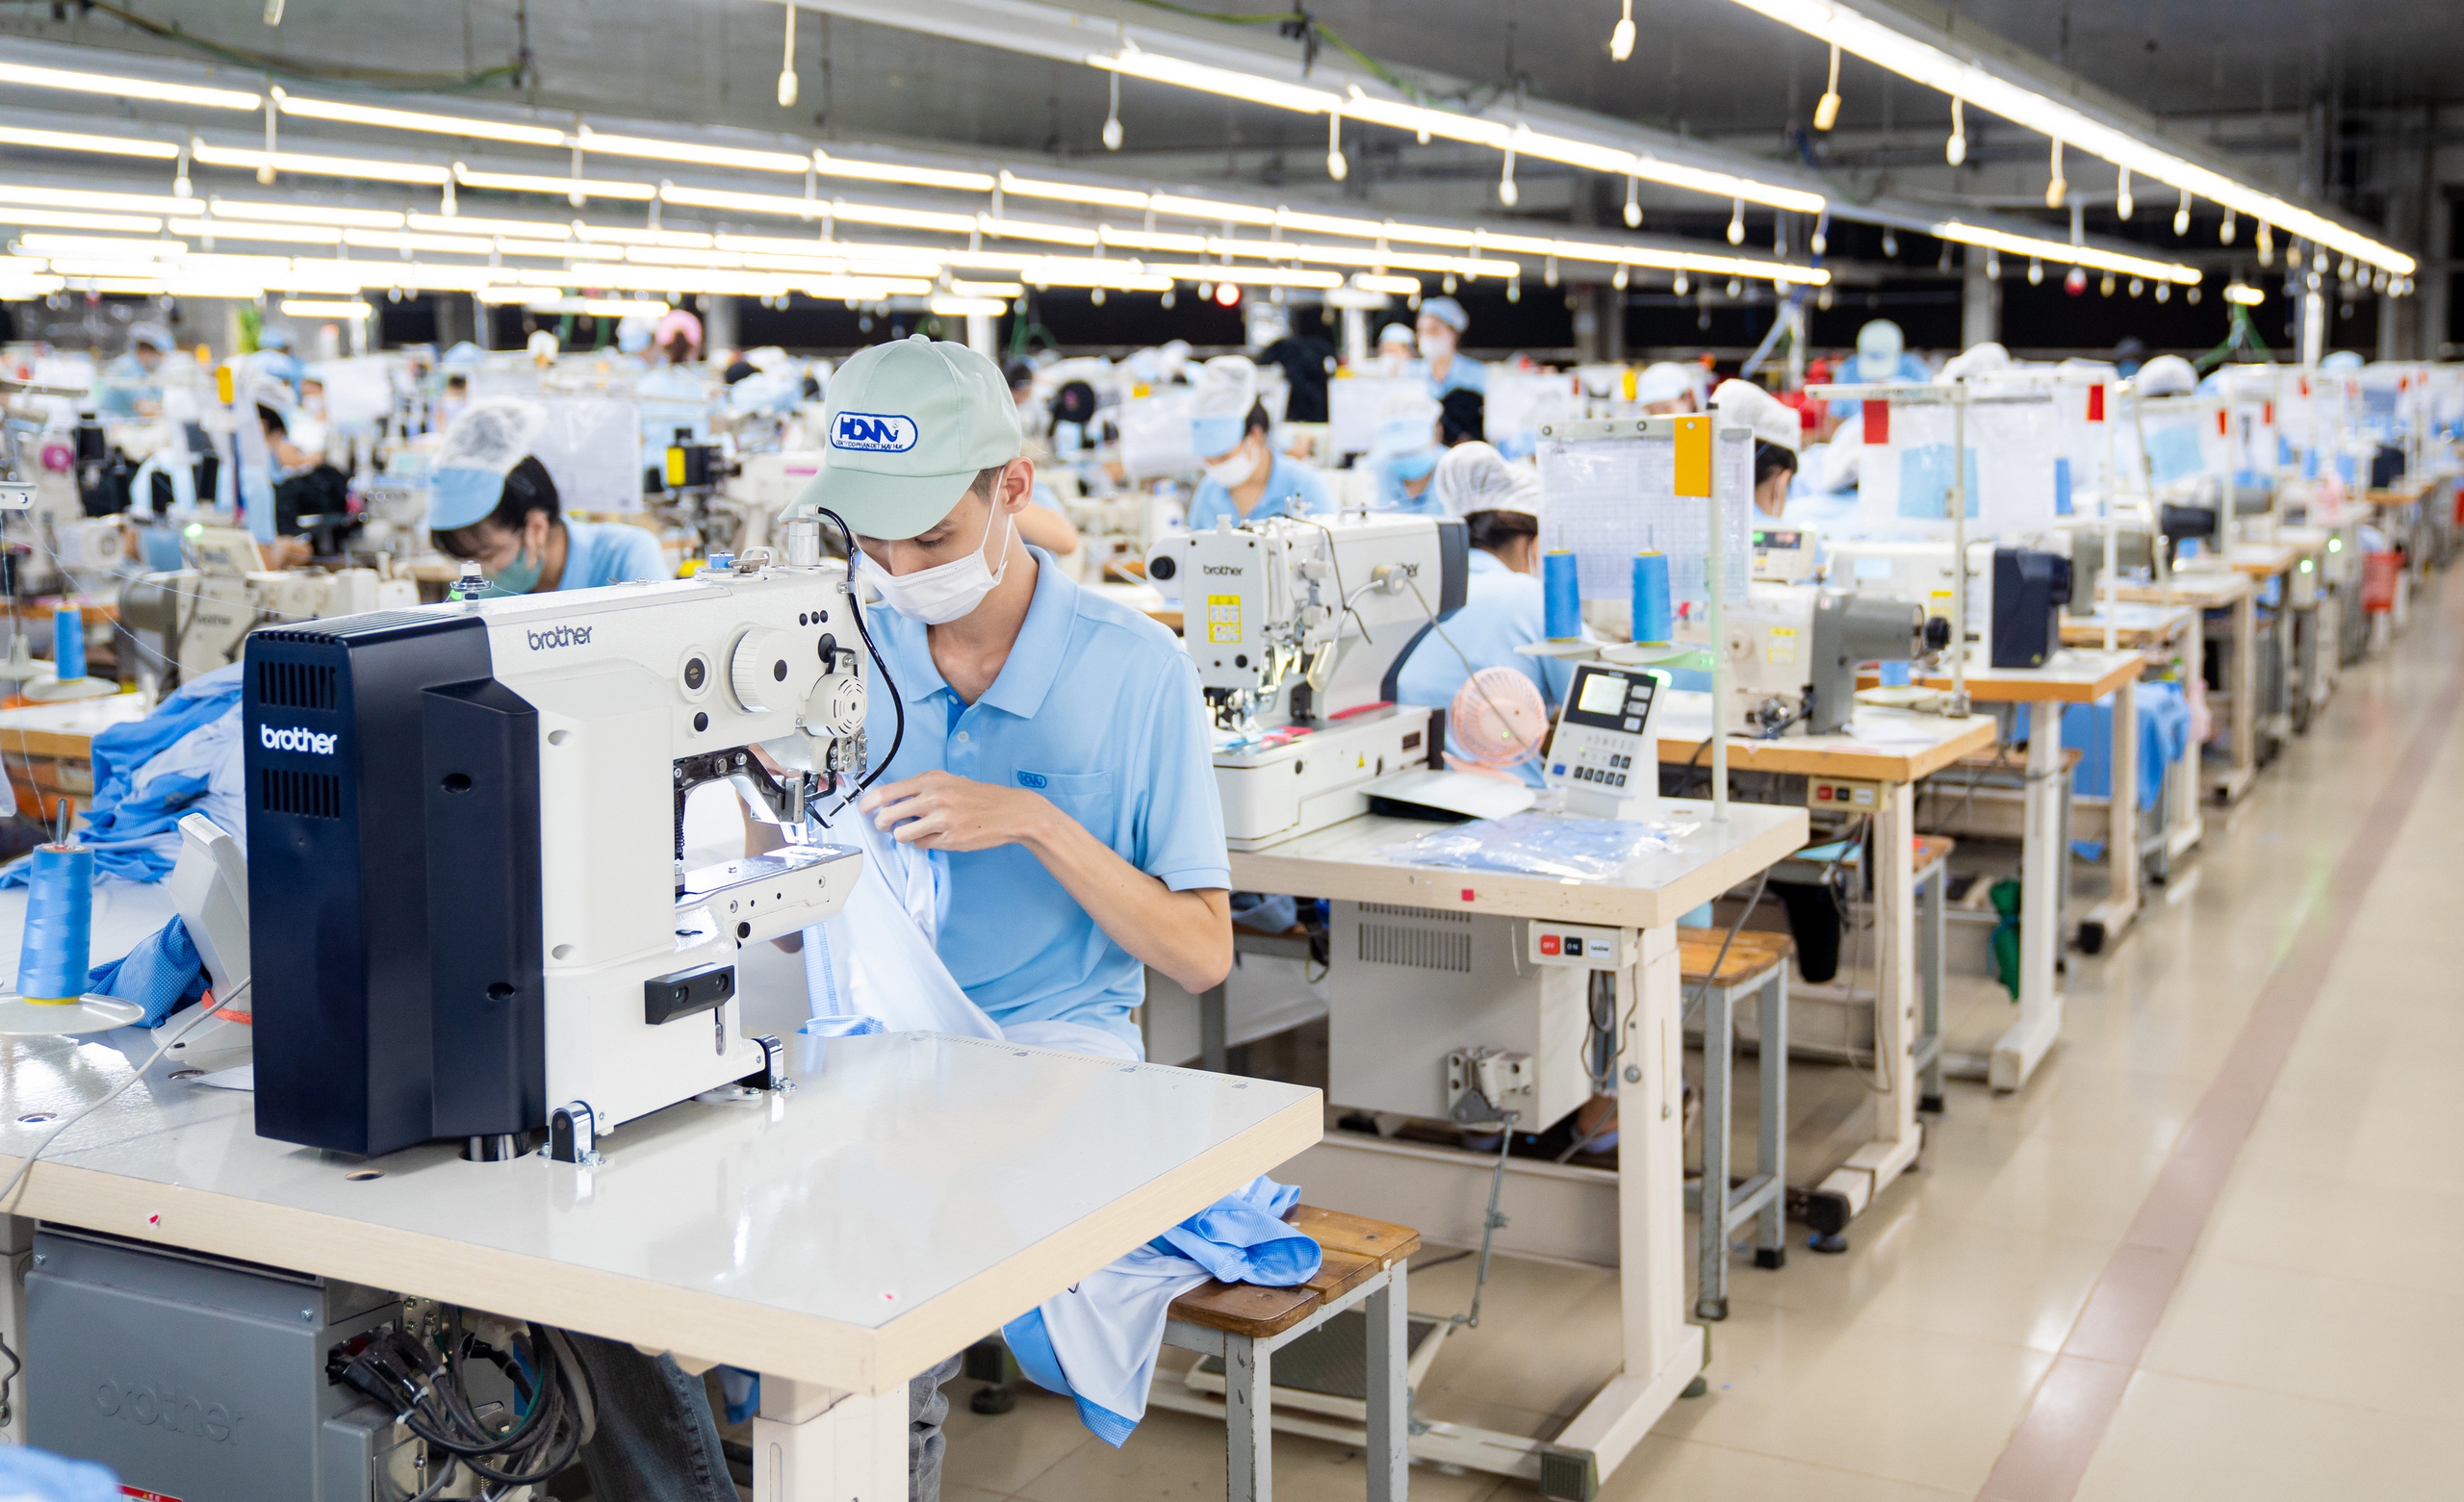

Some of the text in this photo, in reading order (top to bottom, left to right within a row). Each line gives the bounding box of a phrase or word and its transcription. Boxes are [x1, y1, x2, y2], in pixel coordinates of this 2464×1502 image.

[1202, 564, 1244, 576] brother
[526, 624, 593, 651] brother
[261, 724, 338, 755] brother
[1543, 941, 1555, 950] OFF
[90, 1362, 246, 1447] brother
